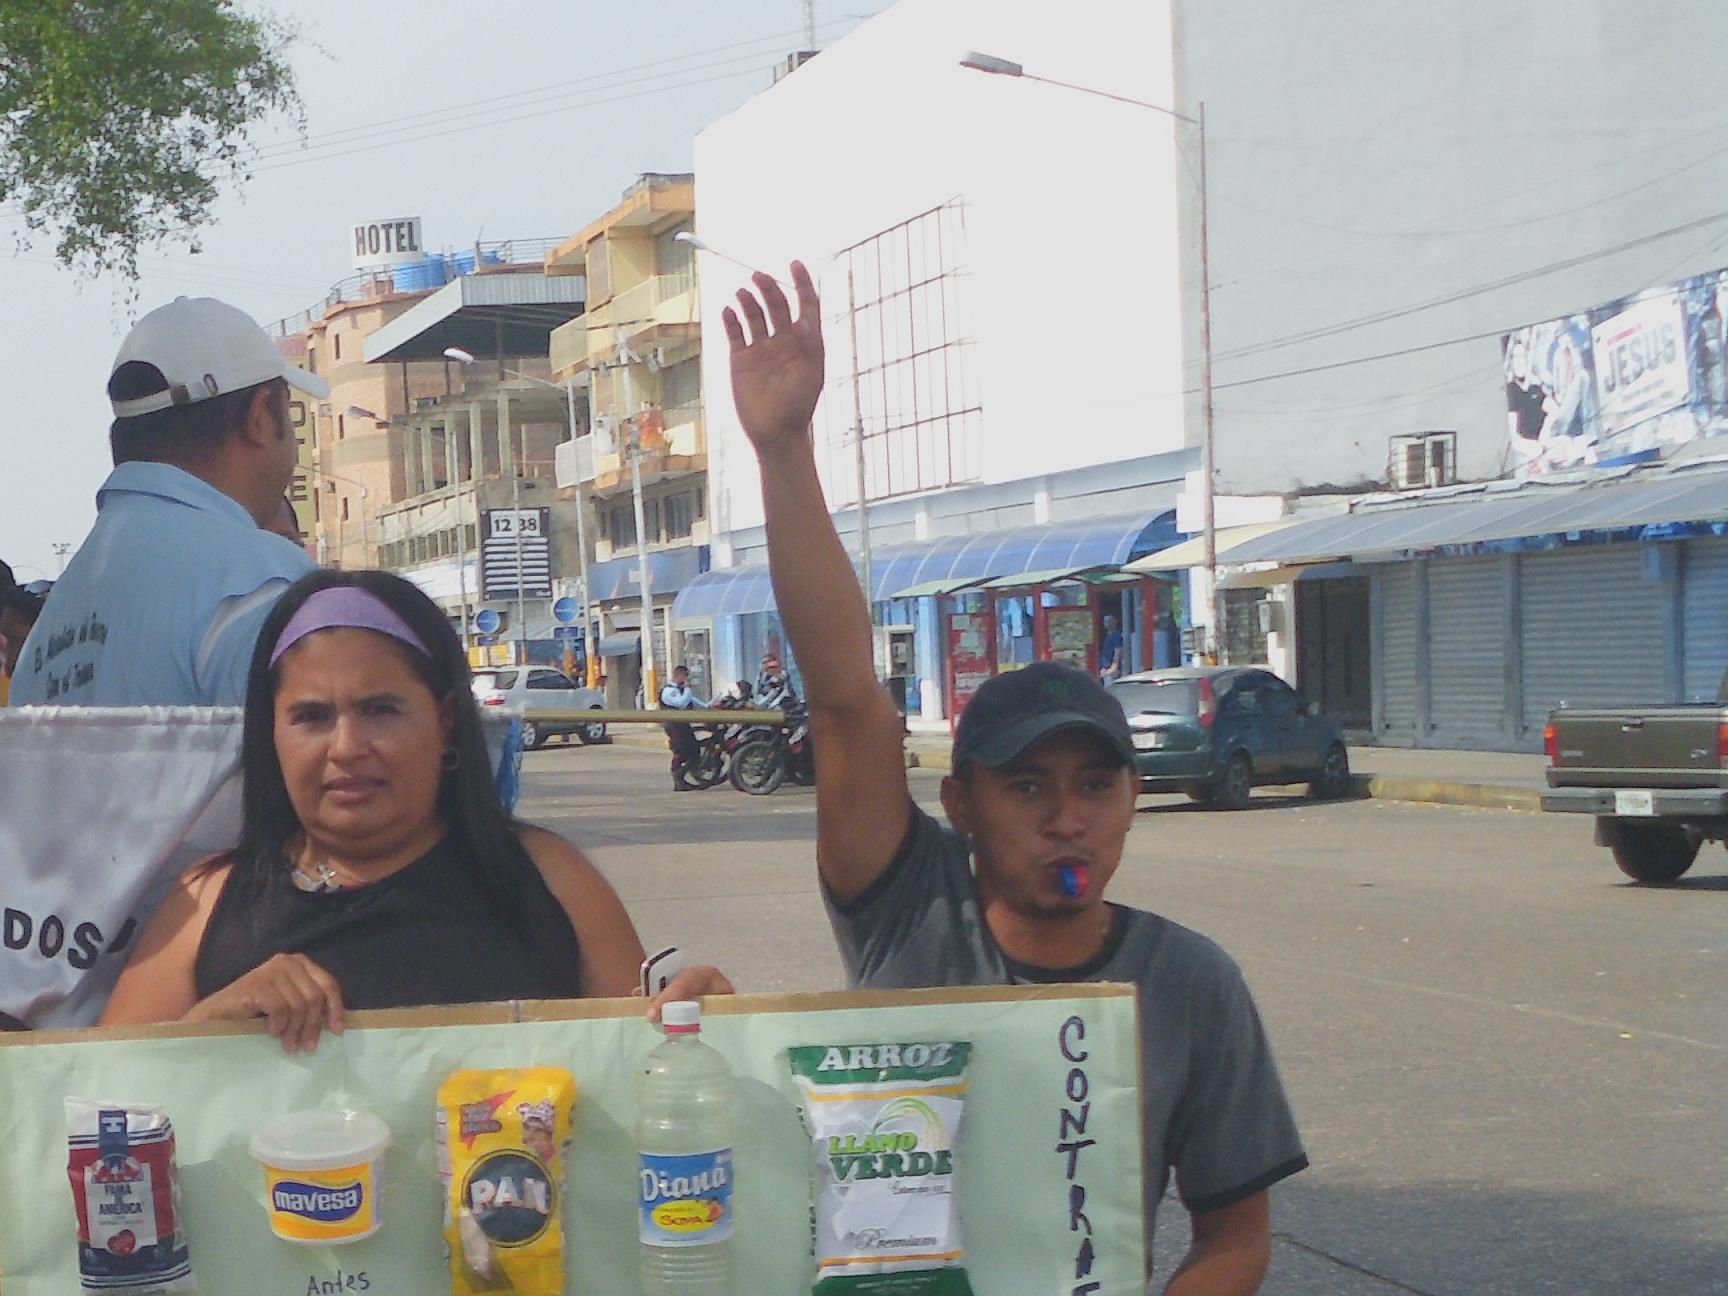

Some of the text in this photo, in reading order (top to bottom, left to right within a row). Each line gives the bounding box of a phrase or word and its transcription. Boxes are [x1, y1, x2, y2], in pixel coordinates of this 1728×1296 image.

[355, 222, 419, 256] HOTEL
[1603, 321, 1676, 394] JESUS
[816, 1043, 953, 1072] ARROZ
[829, 1132, 918, 1155] LLANO
[829, 1151, 953, 1182] VERDE
[640, 1168, 726, 1202] Diana
[273, 1189, 358, 1212] mavesa
[855, 1228, 939, 1249] Premium
[306, 1270, 370, 1296] Antes
